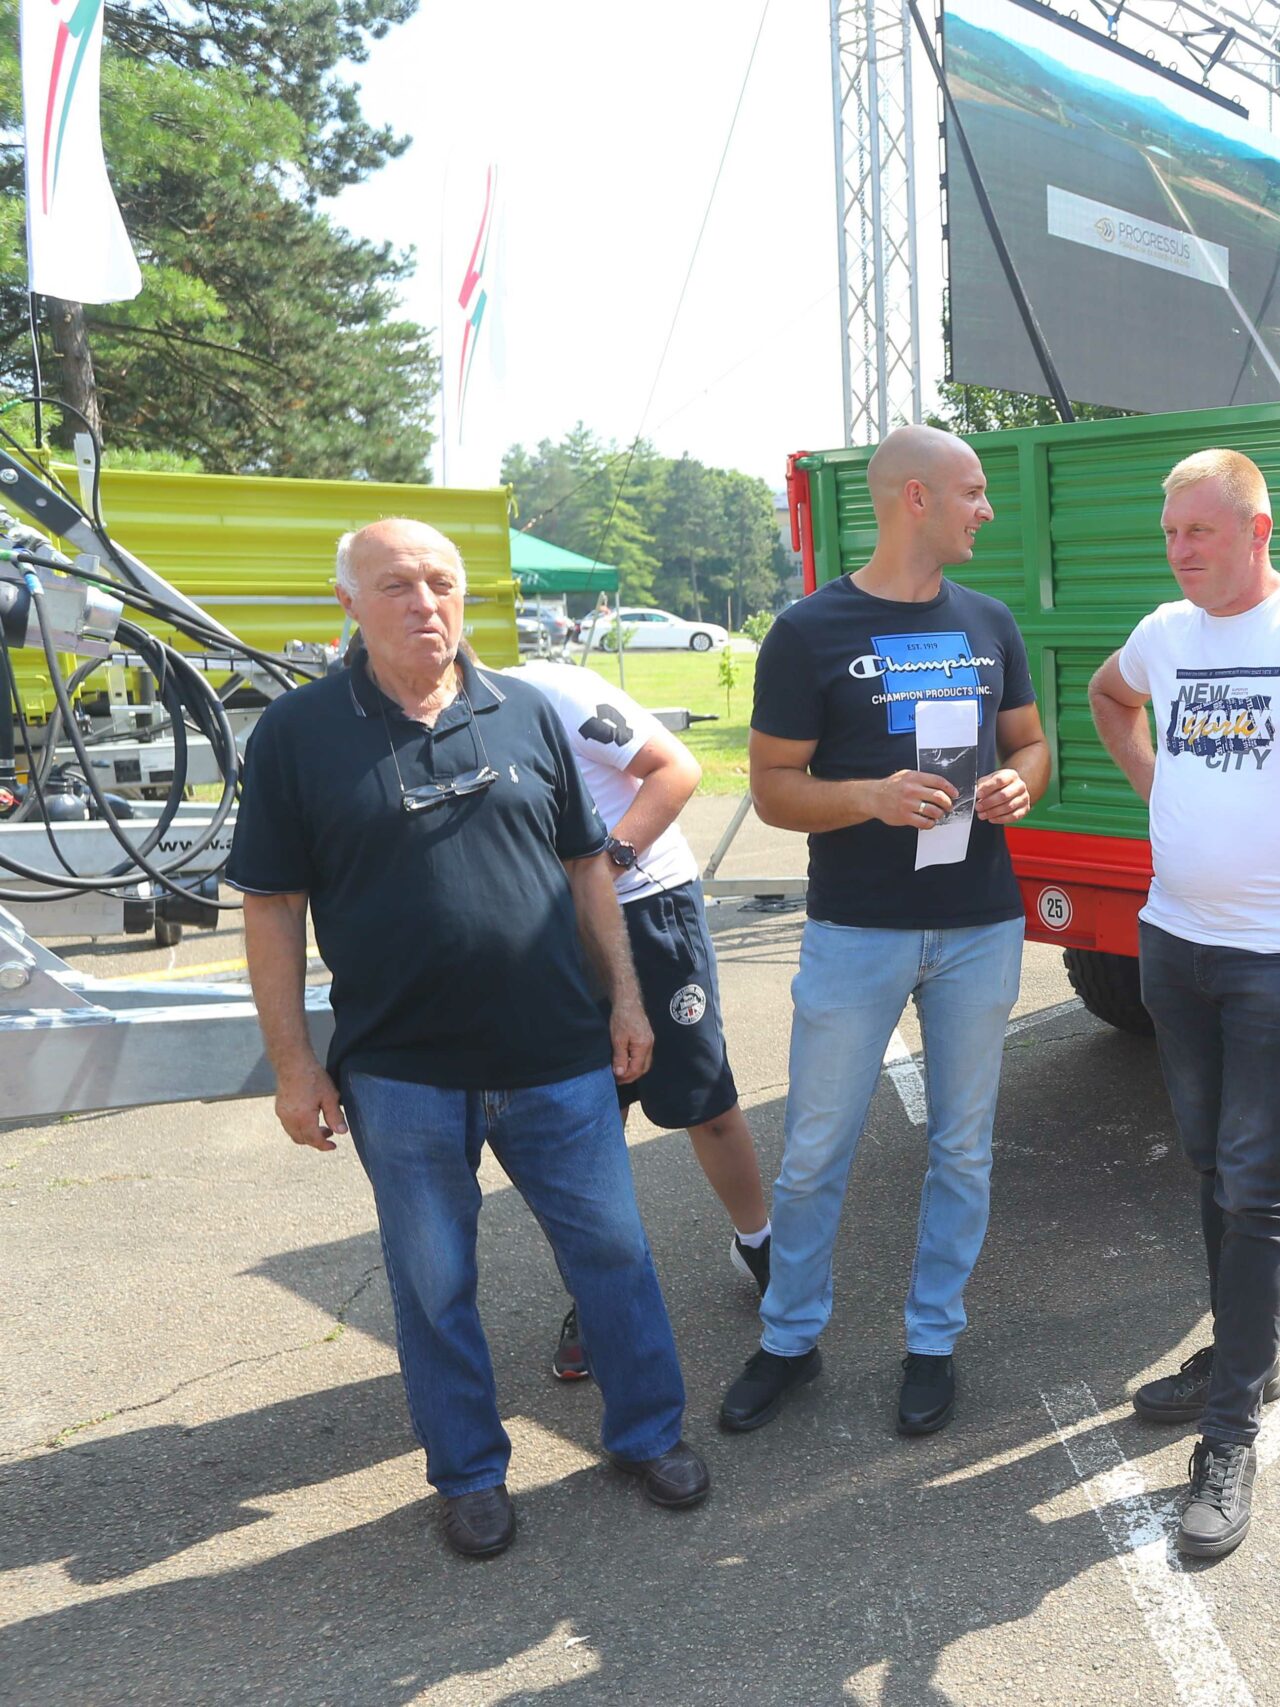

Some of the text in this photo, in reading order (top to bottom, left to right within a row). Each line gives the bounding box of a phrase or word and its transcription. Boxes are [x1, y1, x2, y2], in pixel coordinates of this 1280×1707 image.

[1118, 222, 1191, 260] PROGRESSUS
[906, 642, 939, 651] EST. 1919
[848, 654, 996, 679] Champion
[871, 686, 993, 705] CHAMPION PRODUCTS INC.
[1177, 682, 1231, 704] NEW
[1205, 748, 1273, 773] CITY
[1047, 898, 1063, 919] 25
